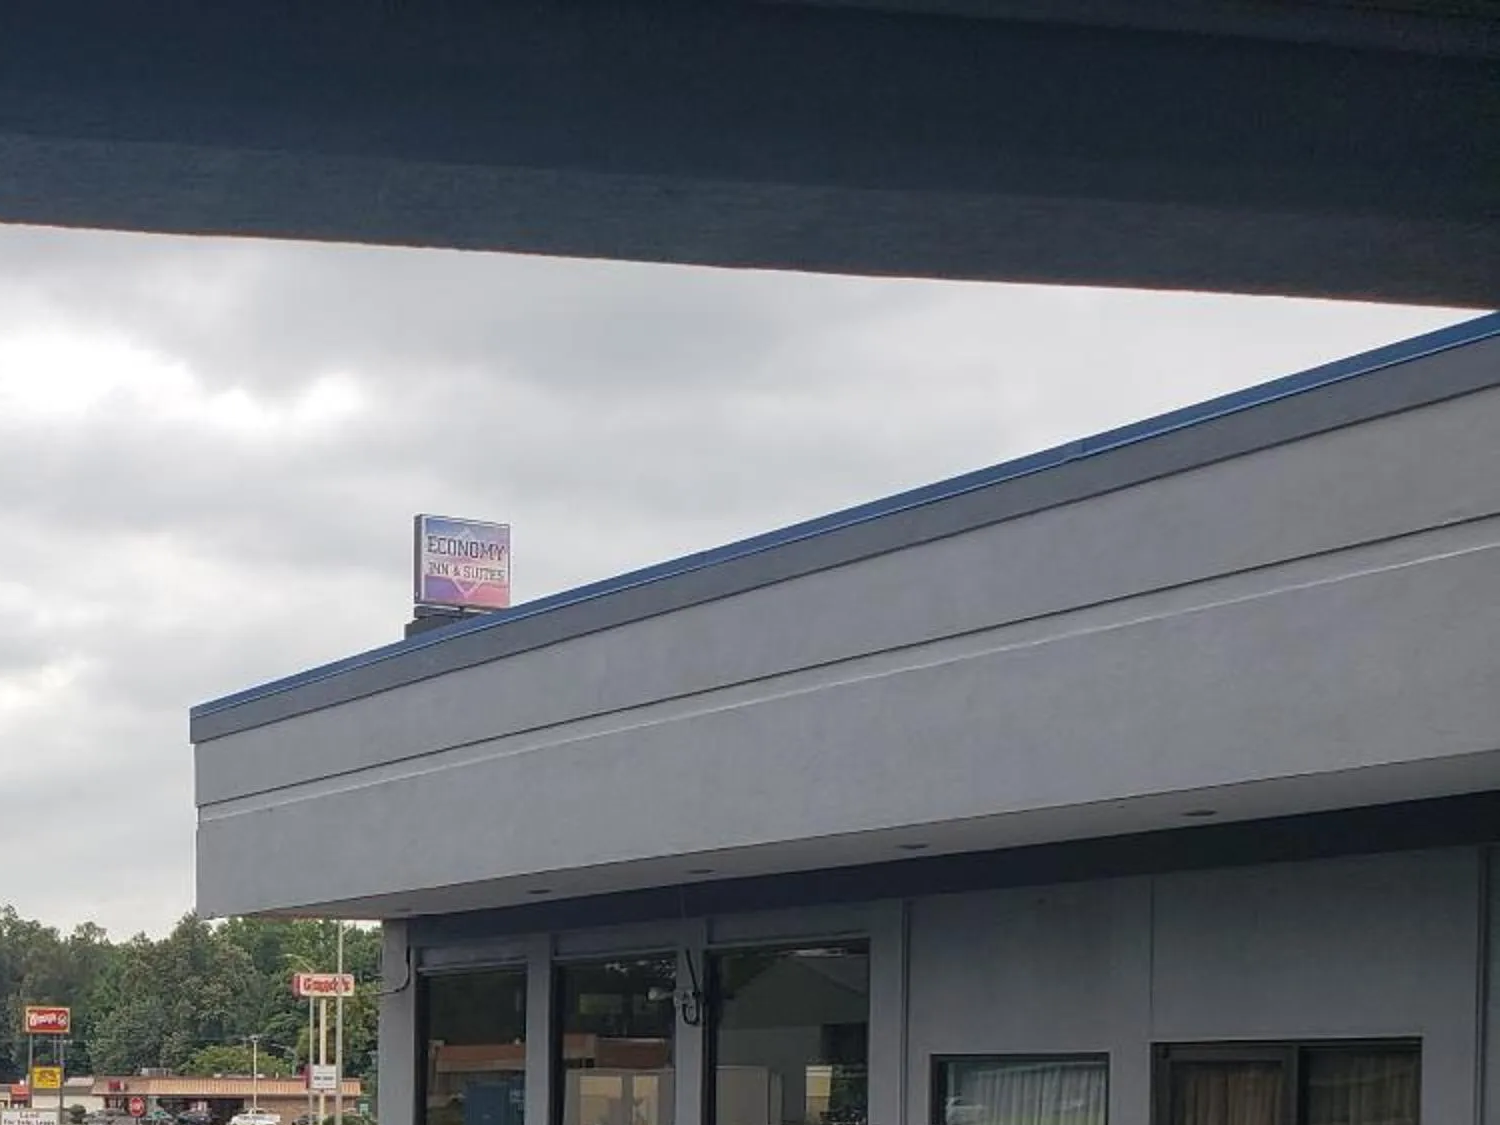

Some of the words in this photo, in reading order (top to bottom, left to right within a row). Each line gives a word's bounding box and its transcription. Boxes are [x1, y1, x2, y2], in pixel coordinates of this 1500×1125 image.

[426, 535, 505, 561] ECONOMY
[428, 561, 449, 576] INN
[463, 565, 505, 581] SUITES
